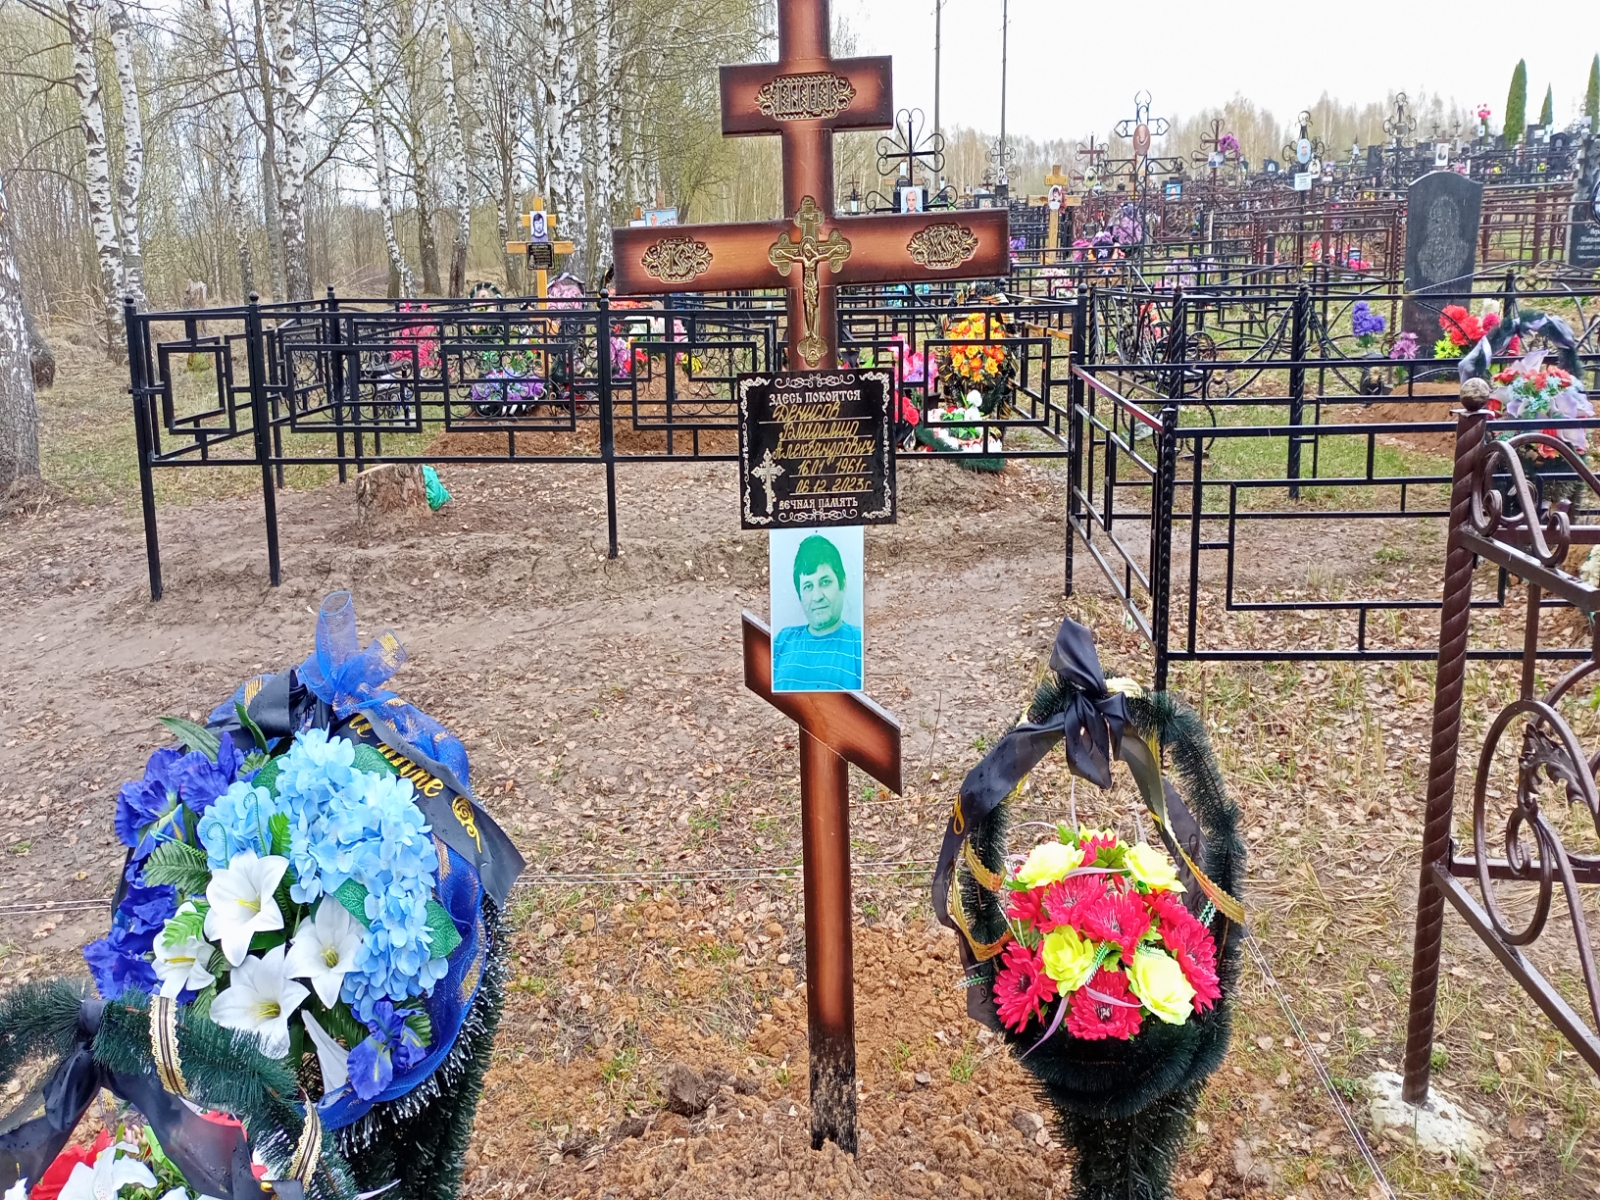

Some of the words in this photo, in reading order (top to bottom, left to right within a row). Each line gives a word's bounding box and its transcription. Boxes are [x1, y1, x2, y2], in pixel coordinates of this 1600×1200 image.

[769, 393, 802, 406] ЗДЕСЬ
[805, 390, 861, 402] ПОКОИТСЯ
[772, 401, 841, 422] Денисов
[779, 499, 816, 509] ВЕЧНАЯ
[818, 497, 858, 508] ПАМЯТЬ
